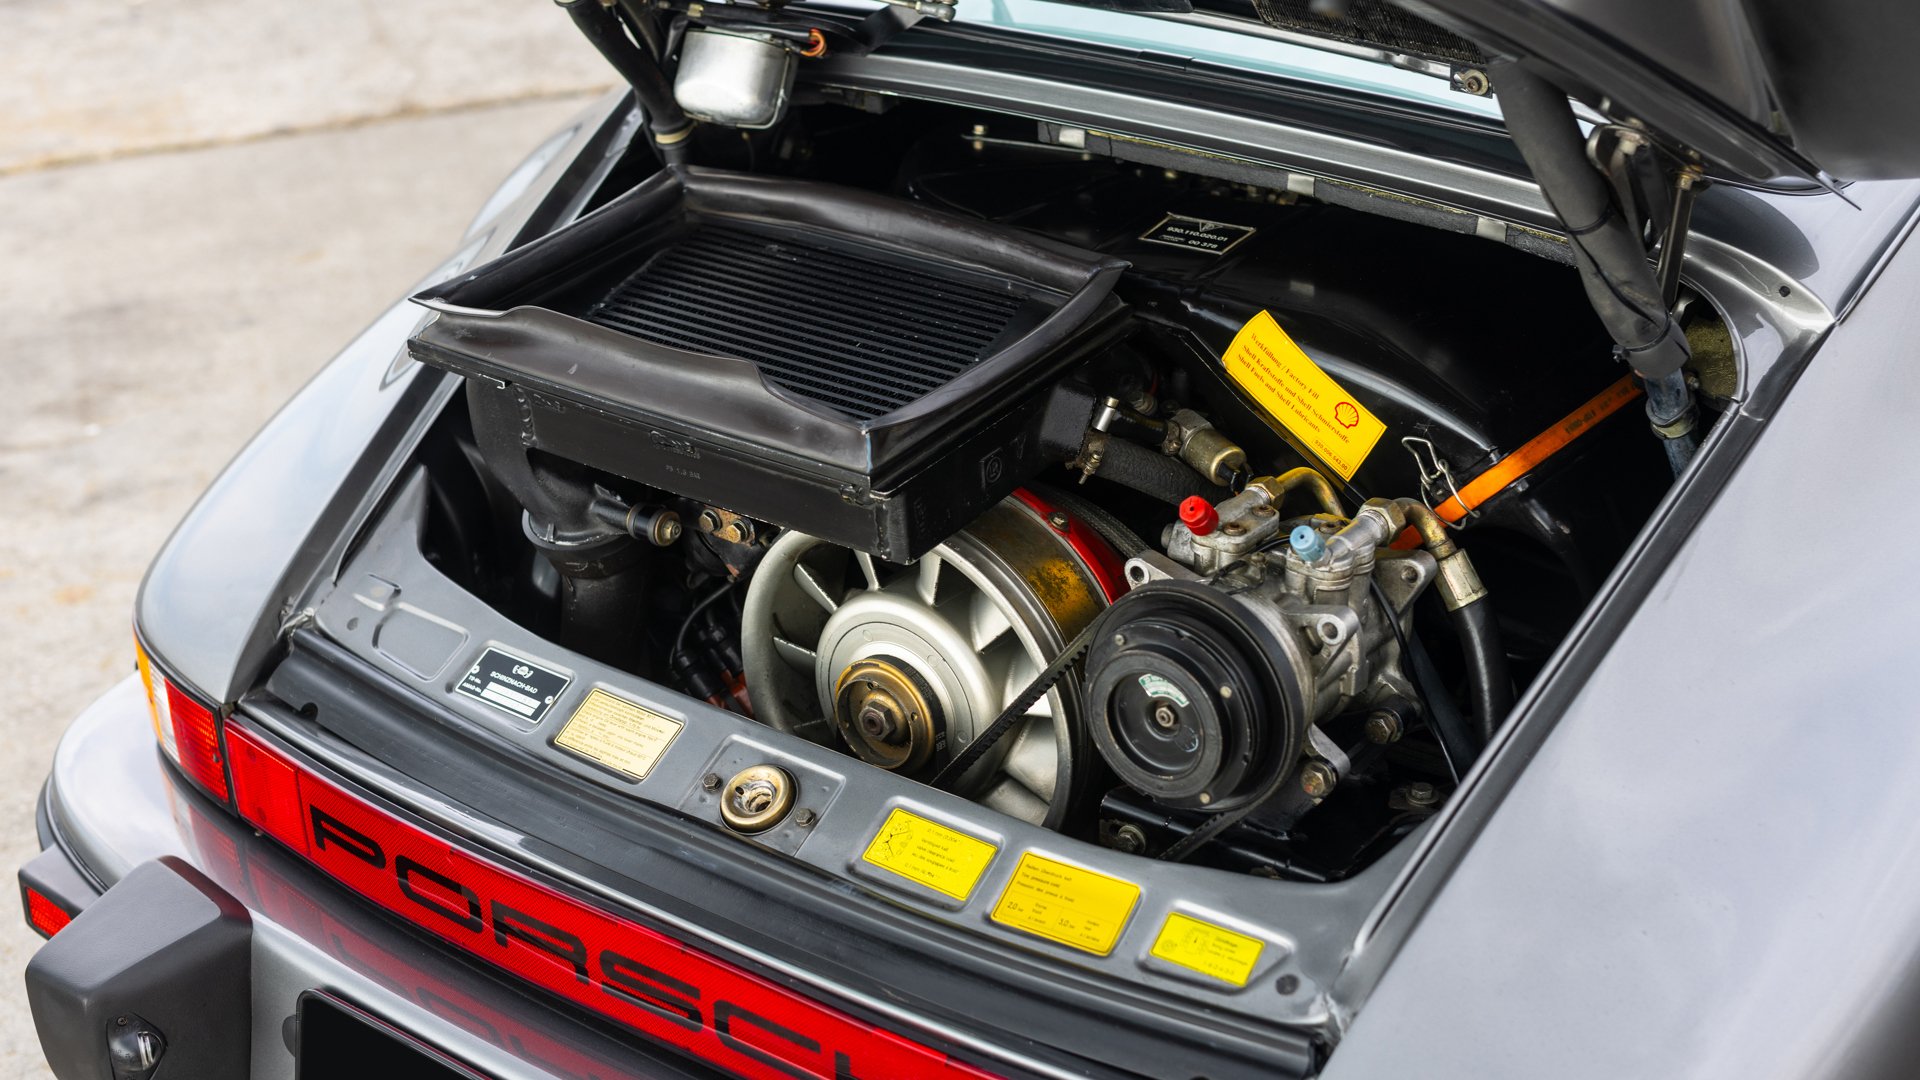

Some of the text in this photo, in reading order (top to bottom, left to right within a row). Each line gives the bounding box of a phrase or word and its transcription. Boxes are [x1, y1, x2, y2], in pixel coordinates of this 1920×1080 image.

[1238, 353, 1251, 369] Shell
[1264, 382, 1276, 394] and
[1276, 391, 1291, 407] Shell
[1290, 405, 1321, 433] Lubricants
[1243, 345, 1257, 360] Shell
[1256, 358, 1285, 387] Kraftstoffe
[1284, 386, 1297, 398] und
[1297, 396, 1312, 411] Shell
[1285, 368, 1307, 390] Factory
[1308, 388, 1320, 400] Fill
